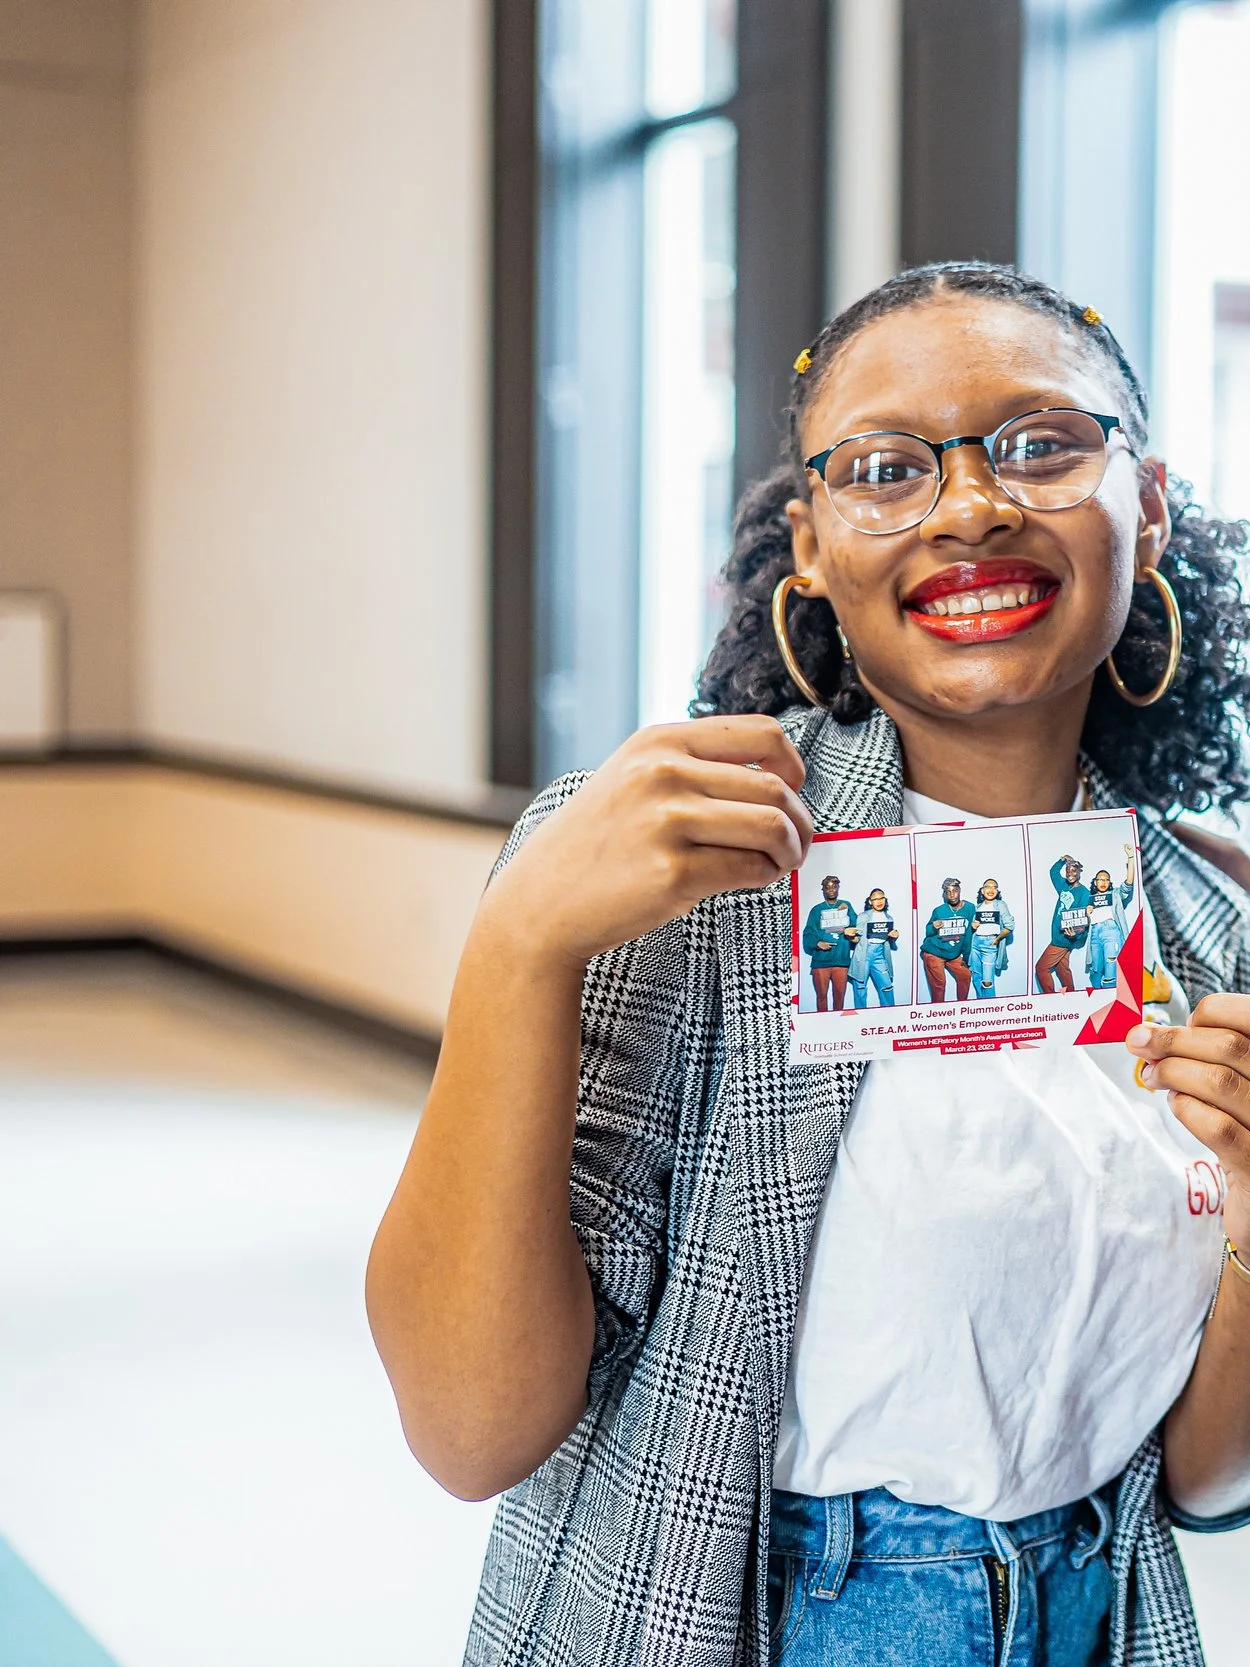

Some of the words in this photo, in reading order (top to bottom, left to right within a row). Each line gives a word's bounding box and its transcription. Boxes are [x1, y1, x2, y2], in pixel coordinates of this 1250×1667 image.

[910, 1010, 923, 1019] Dr.
[926, 1007, 956, 1018] Jewel
[960, 1005, 1004, 1016] Plummer
[1007, 1002, 1033, 1012] Cobb
[860, 1026, 909, 1036] S.T.E.A.M.
[911, 1020, 957, 1032] Women's
[959, 1017, 1031, 1031] Empowerment
[1033, 1012, 1080, 1022] Initiatives
[897, 1039, 928, 1047] Women's
[928, 1036, 959, 1045] HERstory
[960, 1034, 985, 1042] Month's
[986, 1032, 1010, 1040] Awards
[1011, 1029, 1043, 1038] Luncheon
[944, 1045, 966, 1053] March
[977, 1042, 995, 1050] 2023
